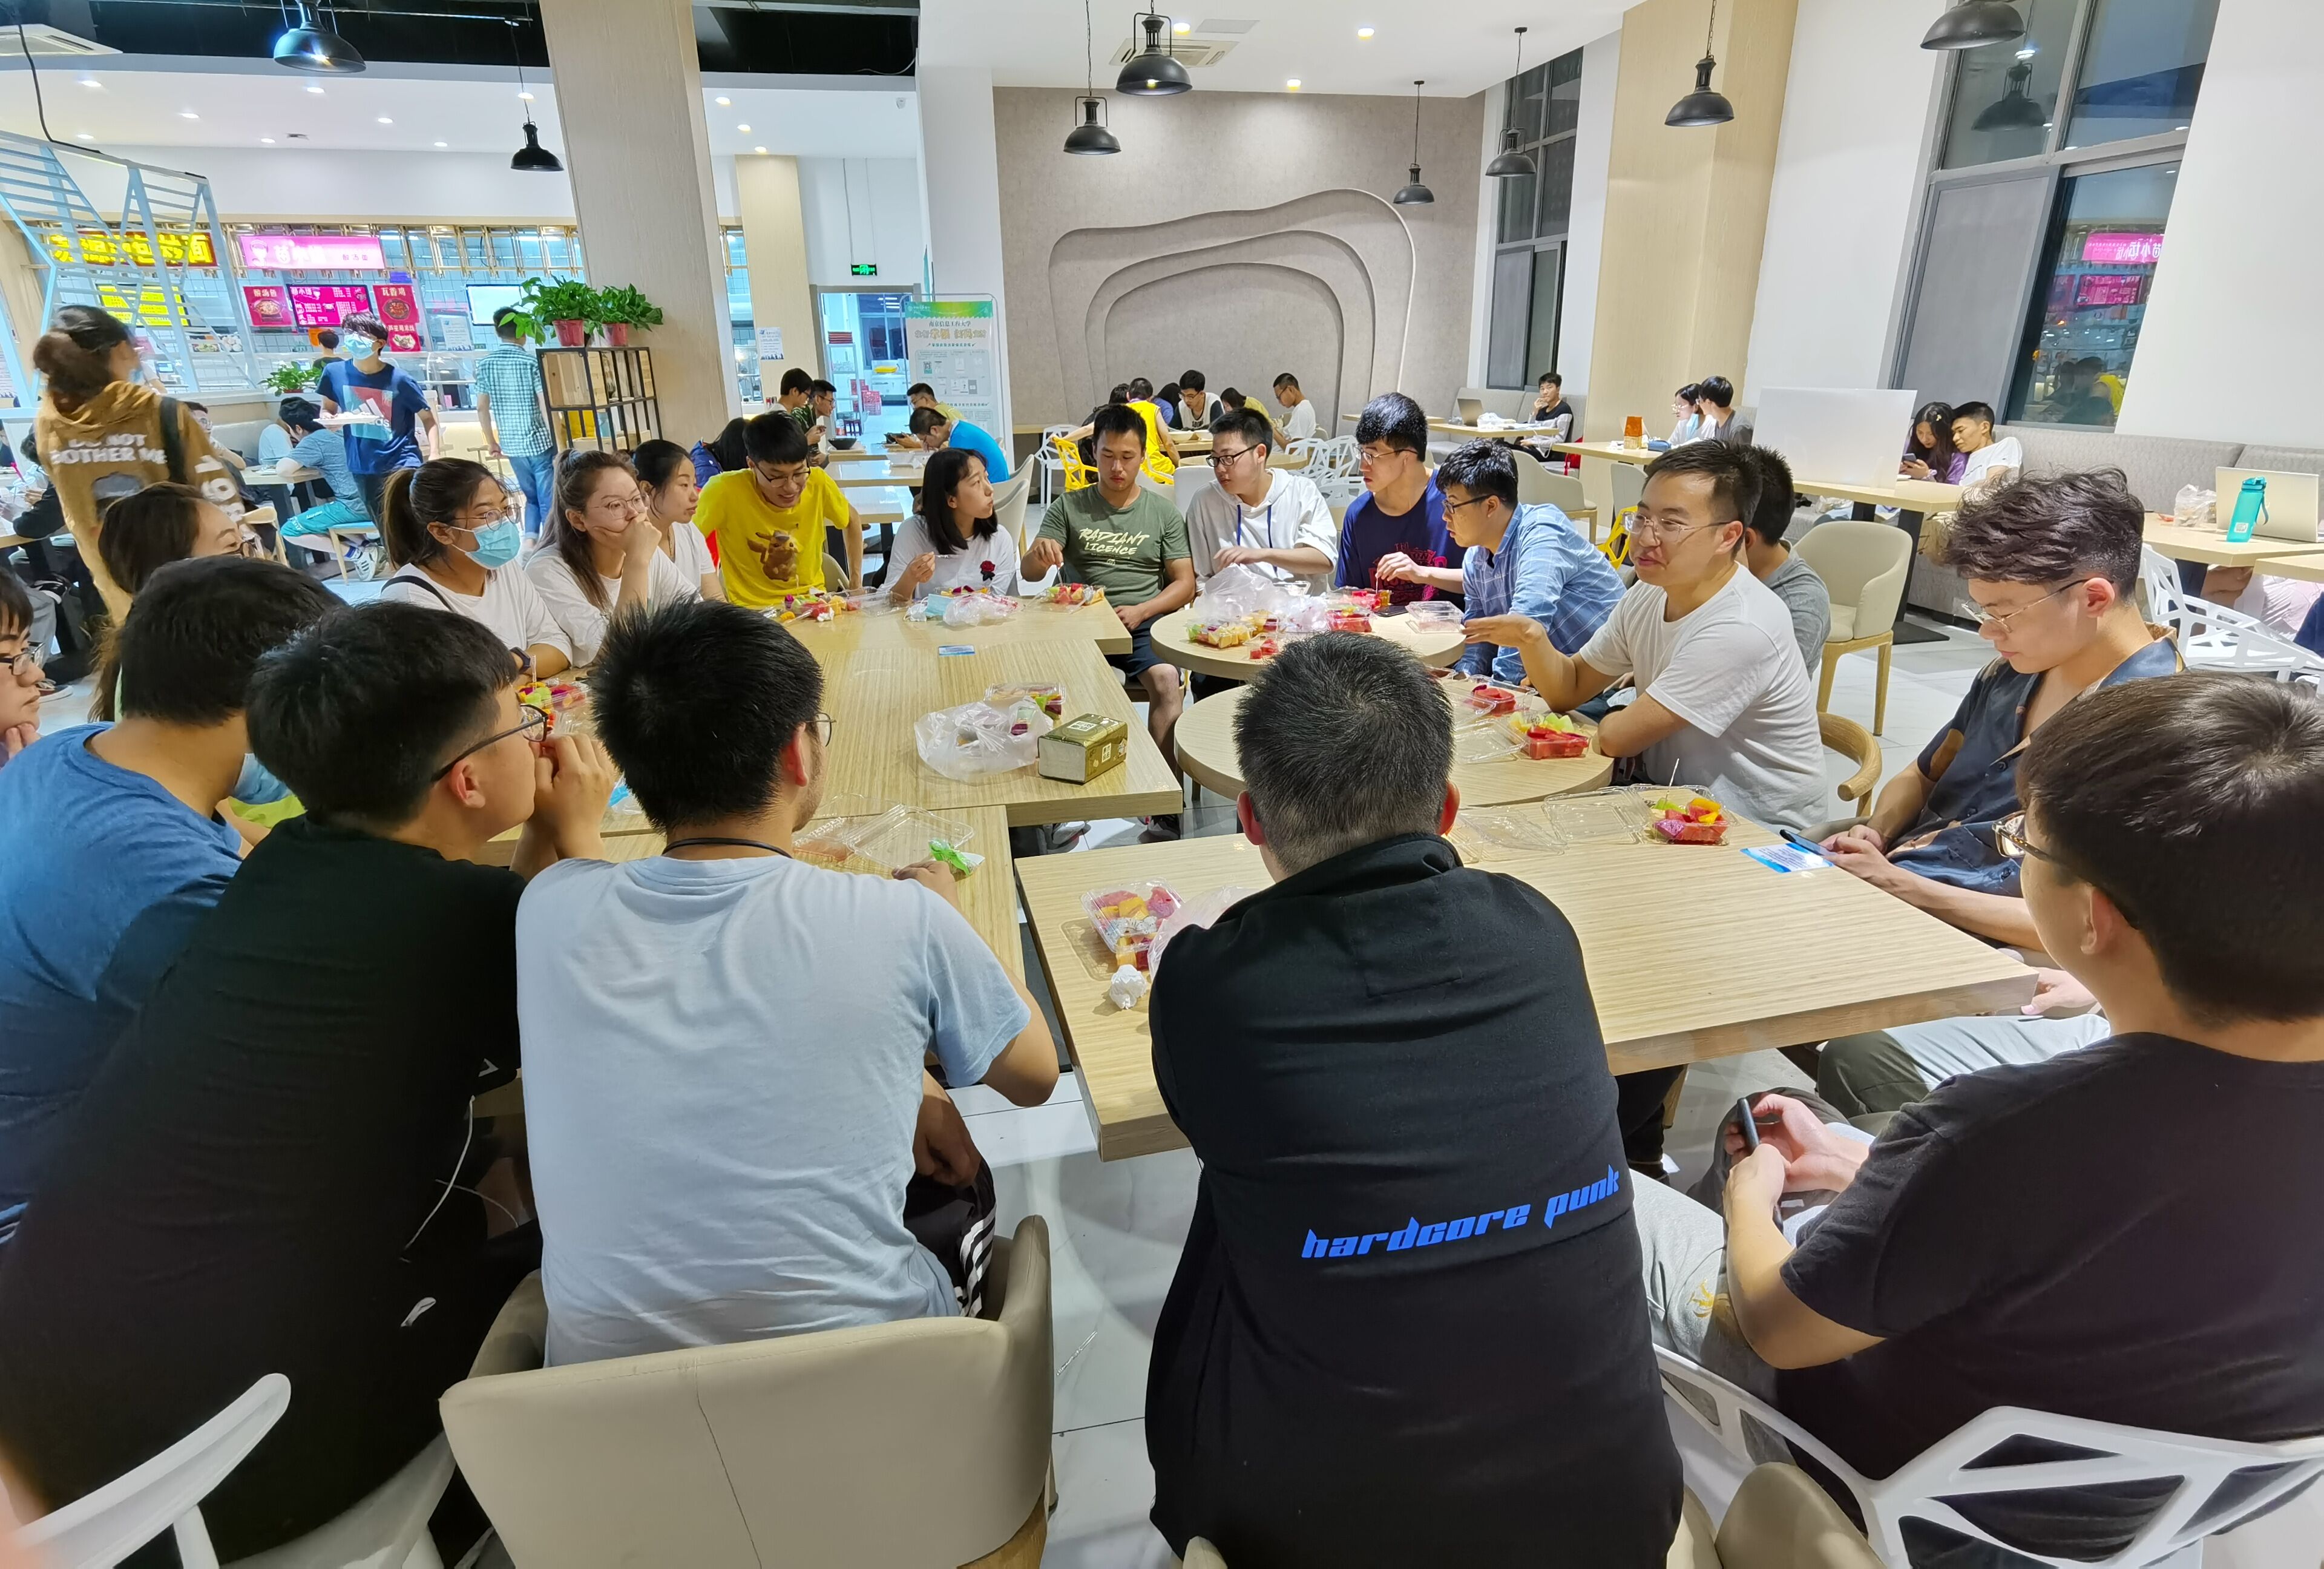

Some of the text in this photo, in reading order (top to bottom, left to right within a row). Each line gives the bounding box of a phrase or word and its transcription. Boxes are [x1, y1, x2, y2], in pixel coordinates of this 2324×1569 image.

[381, 287, 406, 296] 瓦香鸡
[1078, 527, 1150, 545] RADIANT
[1085, 542, 1138, 555] LICENCE
[1301, 1163, 1620, 1258] hardcore punk
